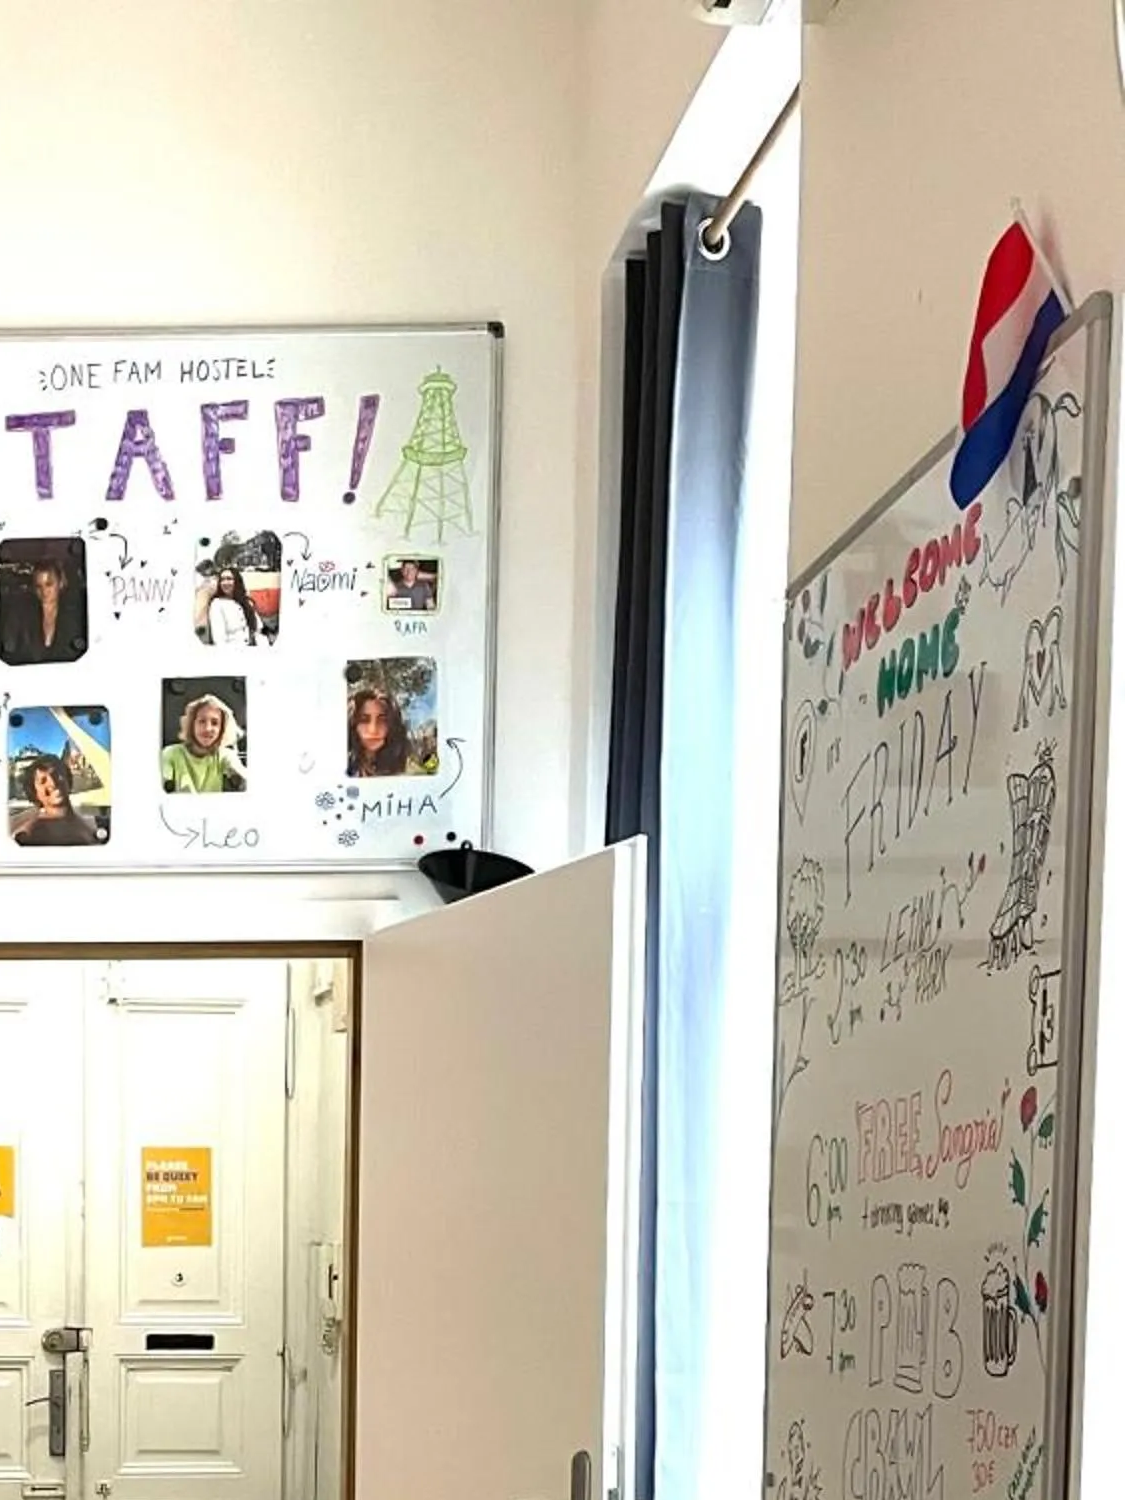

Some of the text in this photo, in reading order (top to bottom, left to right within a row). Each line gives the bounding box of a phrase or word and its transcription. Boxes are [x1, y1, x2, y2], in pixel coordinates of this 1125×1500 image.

[50, 356, 265, 391] ONE FAM HOSTEL
[290, 567, 358, 594] Naomi
[842, 501, 983, 673] WELCOME
[877, 607, 960, 718] HOME
[841, 661, 987, 908] FRIDAY
[162, 1171, 198, 1182] QUIET
[855, 1090, 924, 1185] FREE
